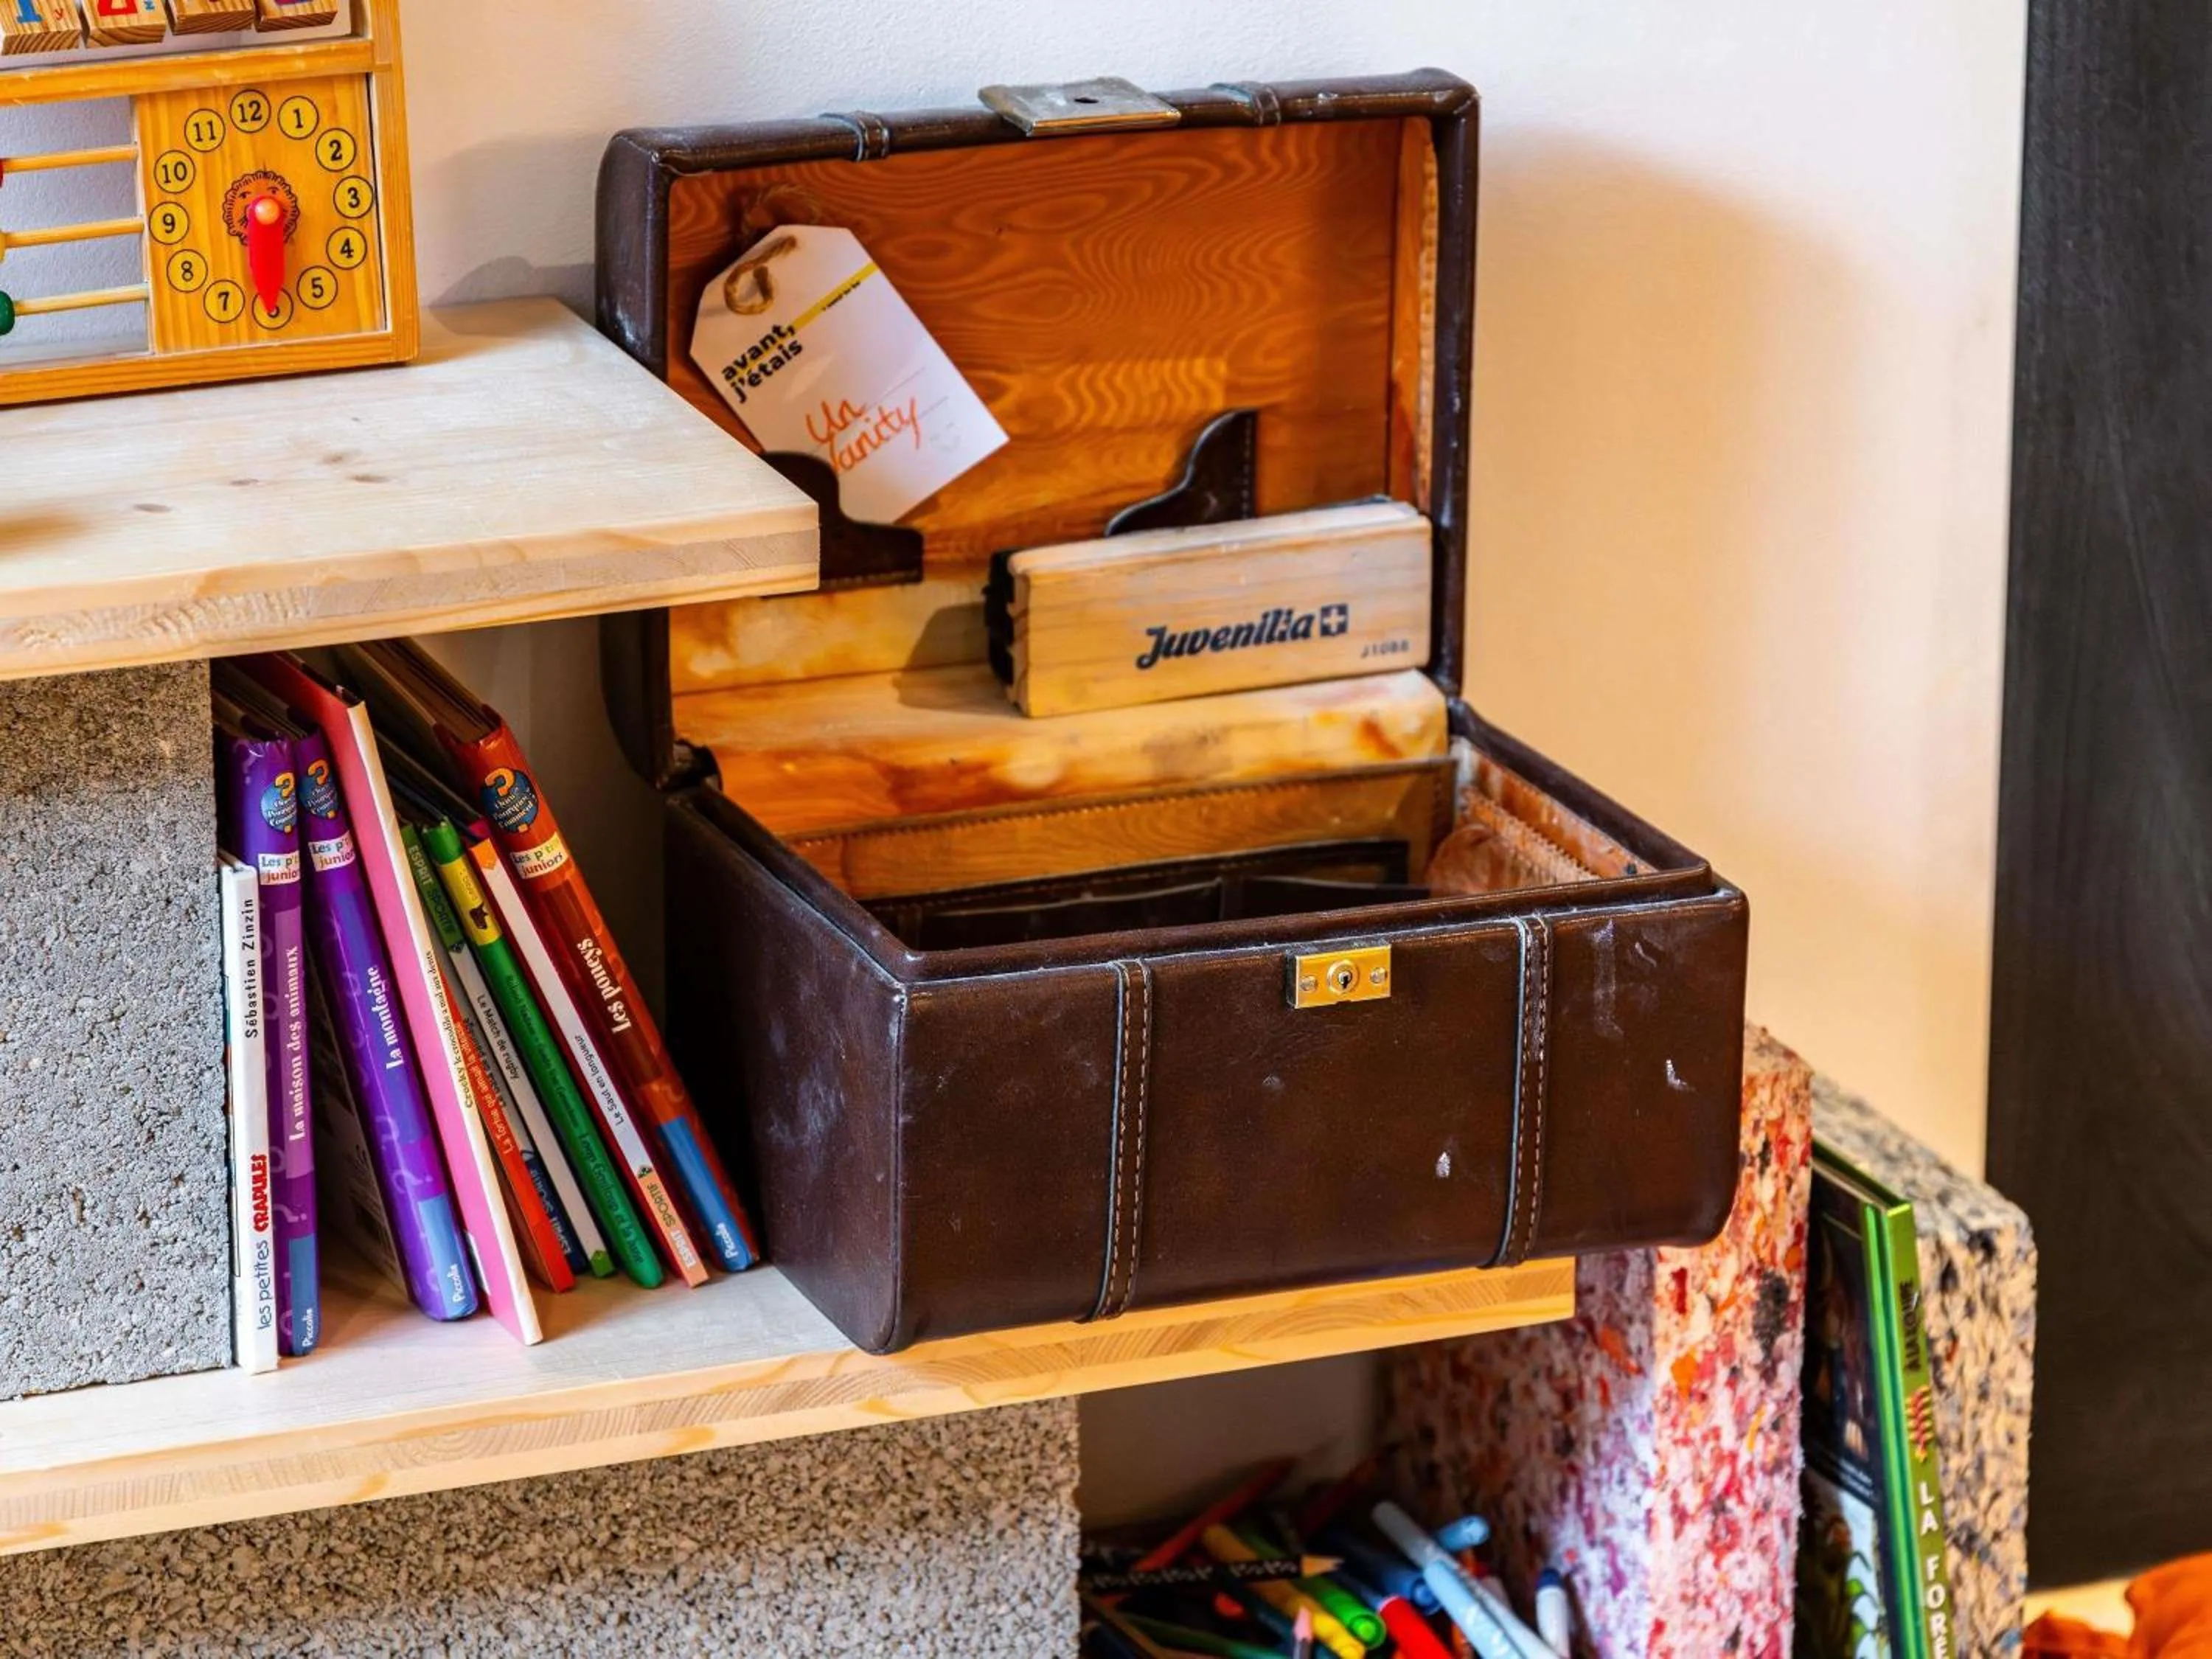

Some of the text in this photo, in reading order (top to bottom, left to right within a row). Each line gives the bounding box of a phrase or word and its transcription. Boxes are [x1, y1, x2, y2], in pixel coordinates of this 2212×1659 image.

[238, 100, 262, 123] 12
[293, 108, 303, 128] 1
[194, 121, 215, 142] 11
[329, 139, 343, 161] 2
[161, 161, 187, 184] 10
[347, 187, 360, 208] 3
[162, 212, 175, 234] 9
[340, 237, 353, 259] 4
[181, 260, 193, 282] 8
[218, 291, 229, 311] 7
[310, 276, 323, 299] 5
[721, 324, 796, 383] avant,
[1135, 608, 1315, 669] Juvenilia
[408, 845, 434, 885] ESPRIT
[241, 899, 258, 1039] Sébastien Zinzin
[577, 938, 632, 1034] Les poneys
[367, 966, 403, 1069] La montagne
[285, 946, 305, 1141] La maison des animaux
[483, 1007, 501, 1038] Match
[498, 1038, 507, 1051] de
[503, 1053, 519, 1079] rugby
[575, 1034, 697, 1268] ESPRIT SPORTIF Le Saut en longueur
[254, 1239, 274, 1300] petites
[1919, 1481, 1938, 1536] LA
